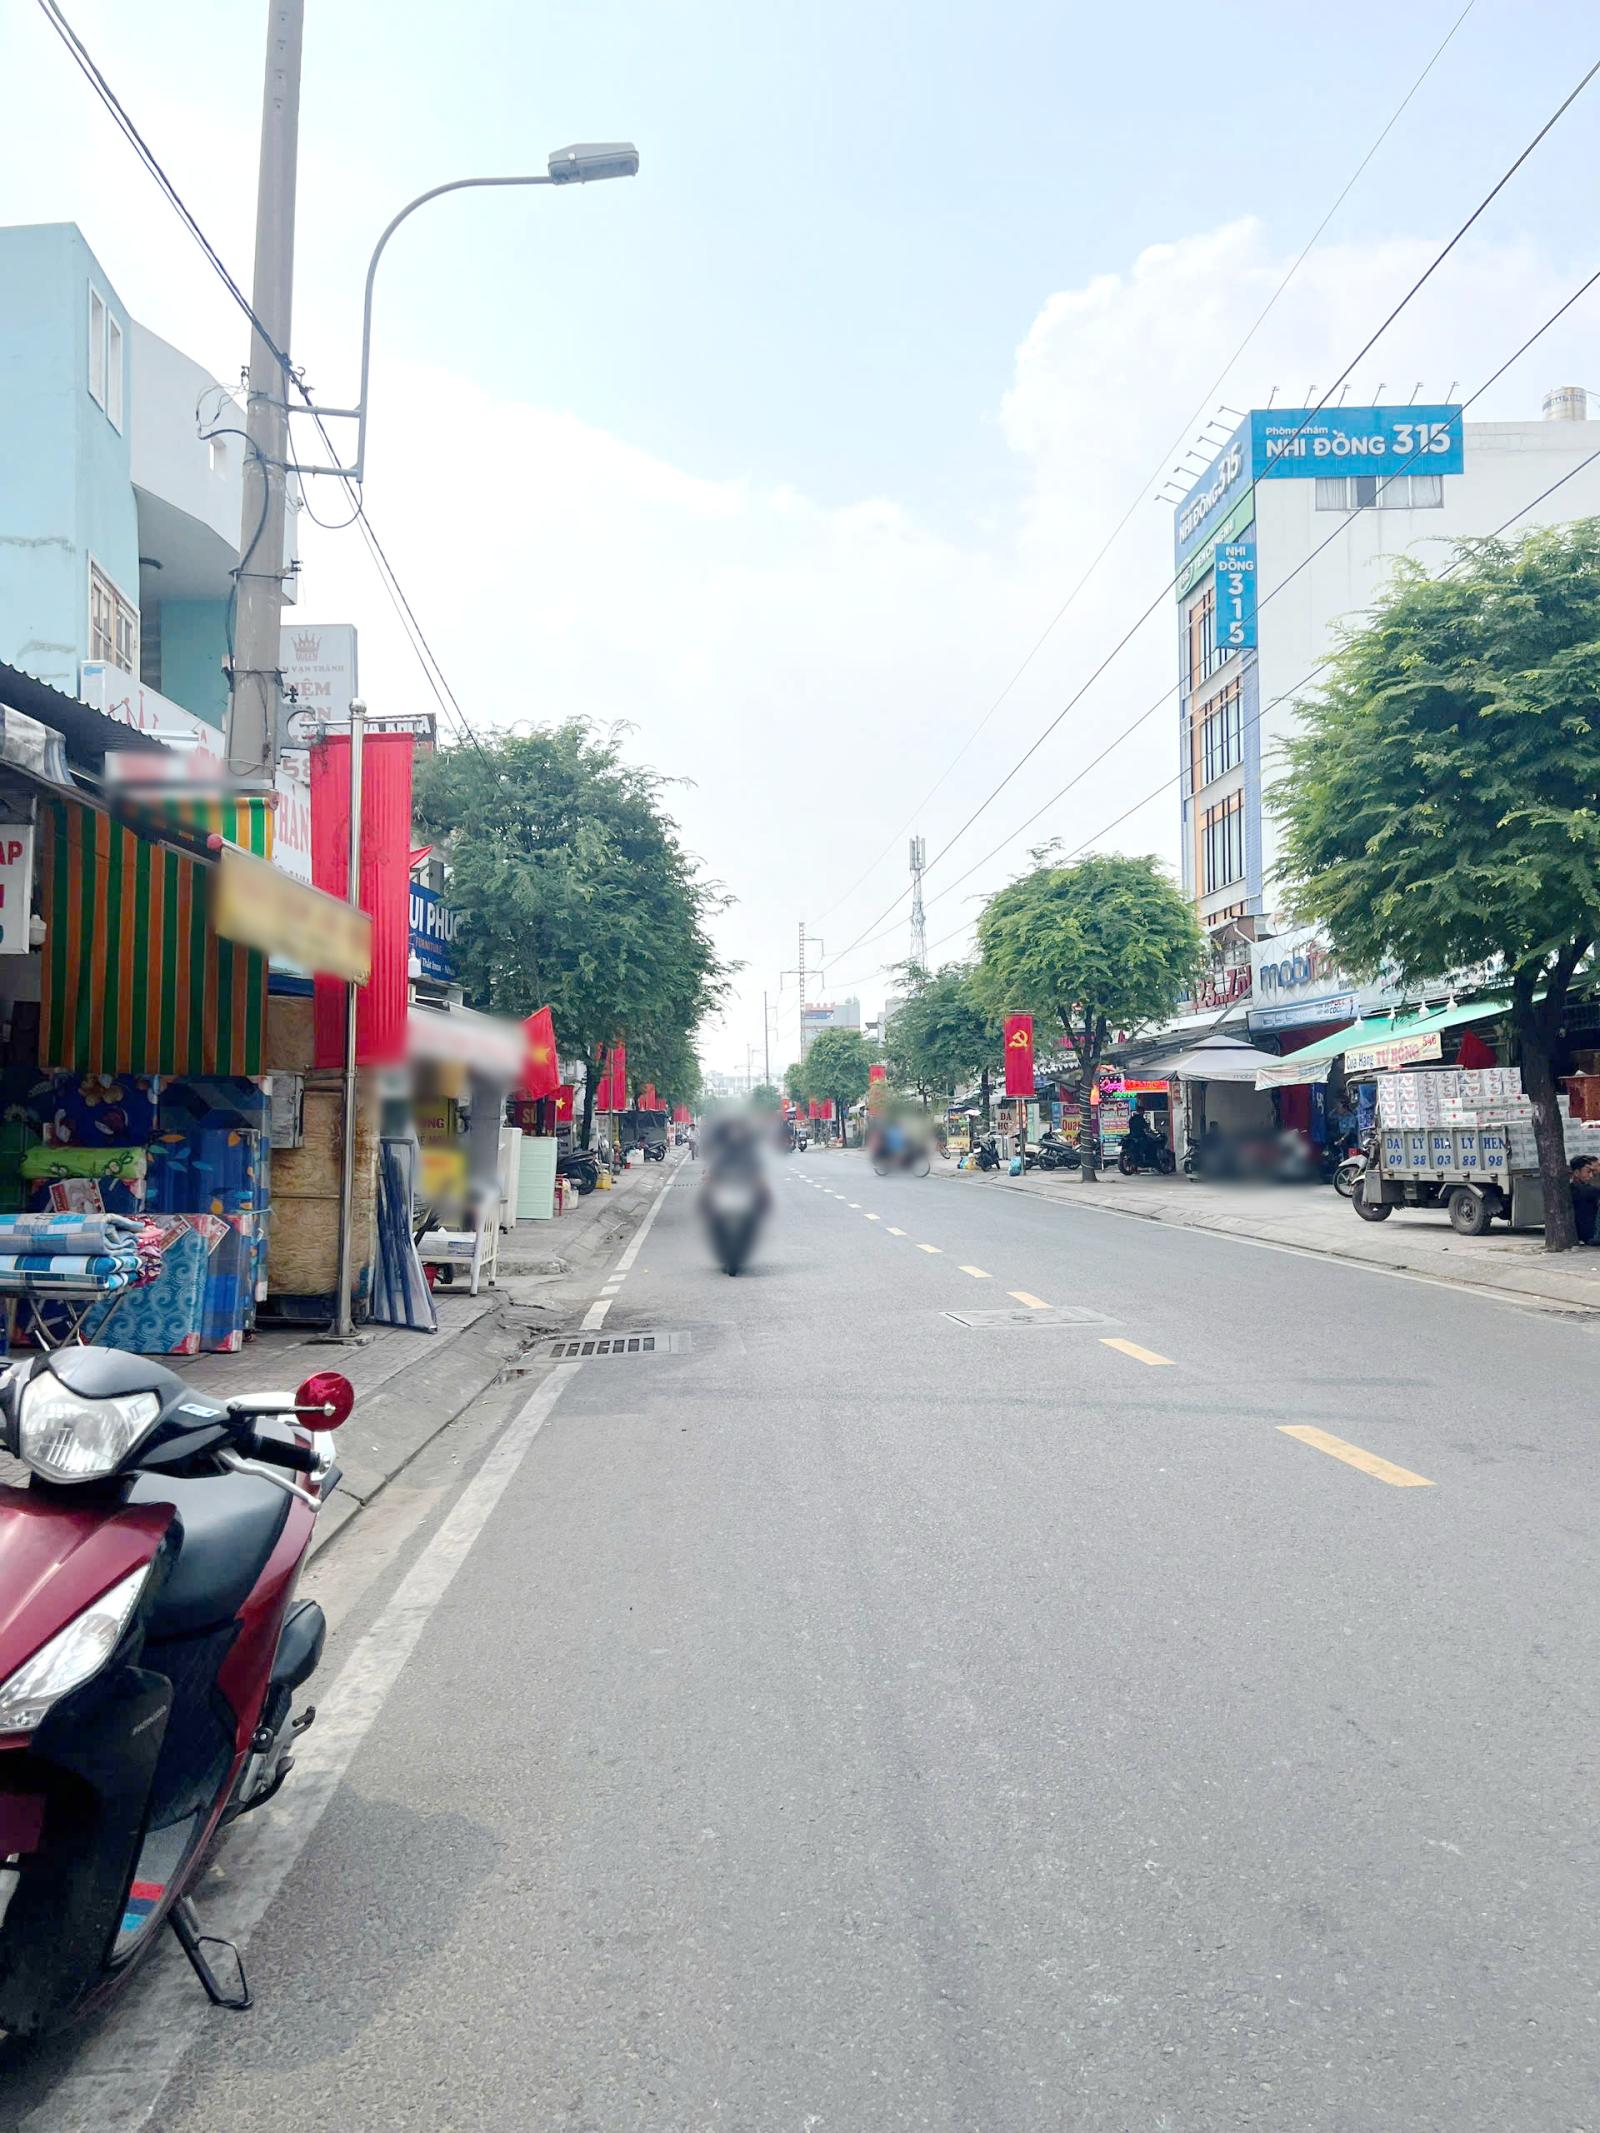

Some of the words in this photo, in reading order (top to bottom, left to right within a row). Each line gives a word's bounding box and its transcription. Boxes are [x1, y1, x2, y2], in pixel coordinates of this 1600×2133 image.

[1266, 438, 1306, 458] NHI
[1313, 429, 1386, 457] ĐỒNG
[1392, 423, 1451, 455] 315
[1225, 546, 1246, 556] NHI
[1218, 556, 1254, 571] ĐỒNG
[1389, 1155, 1403, 1165] 09
[1413, 1155, 1426, 1165] 38
[1437, 1155, 1451, 1165] 03
[1488, 1155, 1504, 1167] 98
